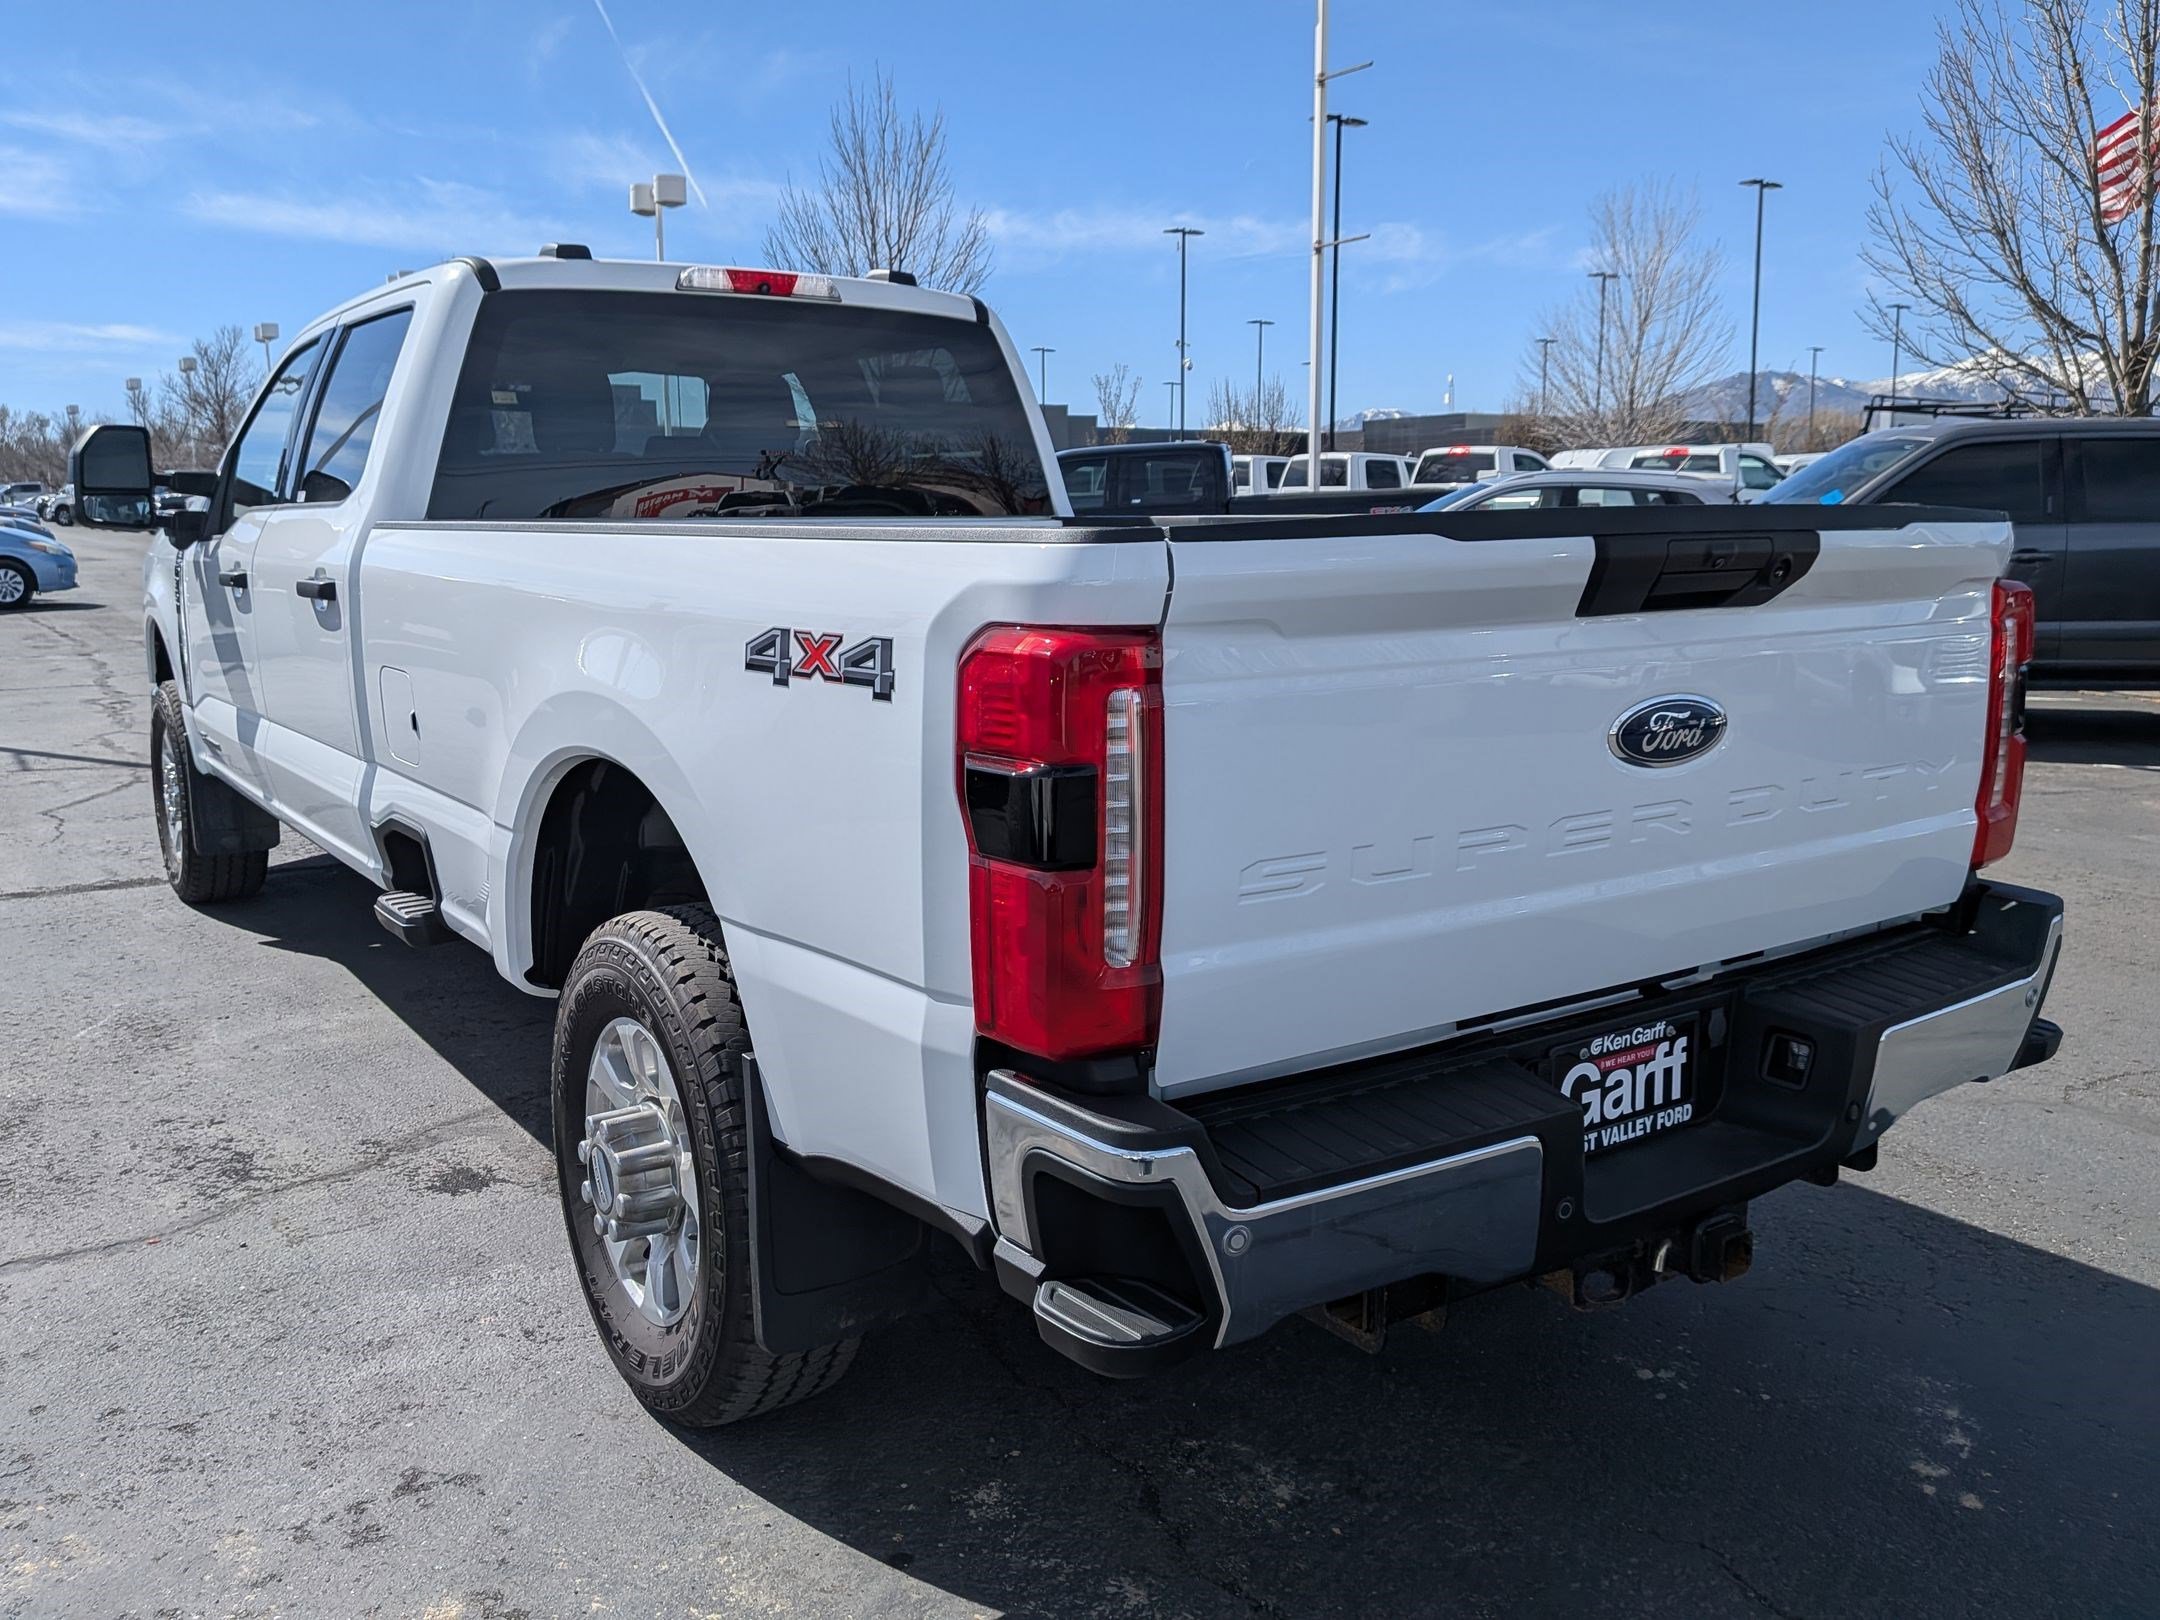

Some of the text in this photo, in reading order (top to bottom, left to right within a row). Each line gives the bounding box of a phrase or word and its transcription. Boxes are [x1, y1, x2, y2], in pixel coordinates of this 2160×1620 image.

[1642, 711, 1706, 752] Ford
[1237, 755, 1957, 906] SUPER DUTY
[1602, 1021, 1666, 1053] Ken Garff
[1605, 1049, 1651, 1068] WE HEAR YOU
[1560, 1037, 1688, 1127] Garff
[1601, 1115, 1654, 1147] VALLEY
[1656, 1103, 1693, 1130] FORD
